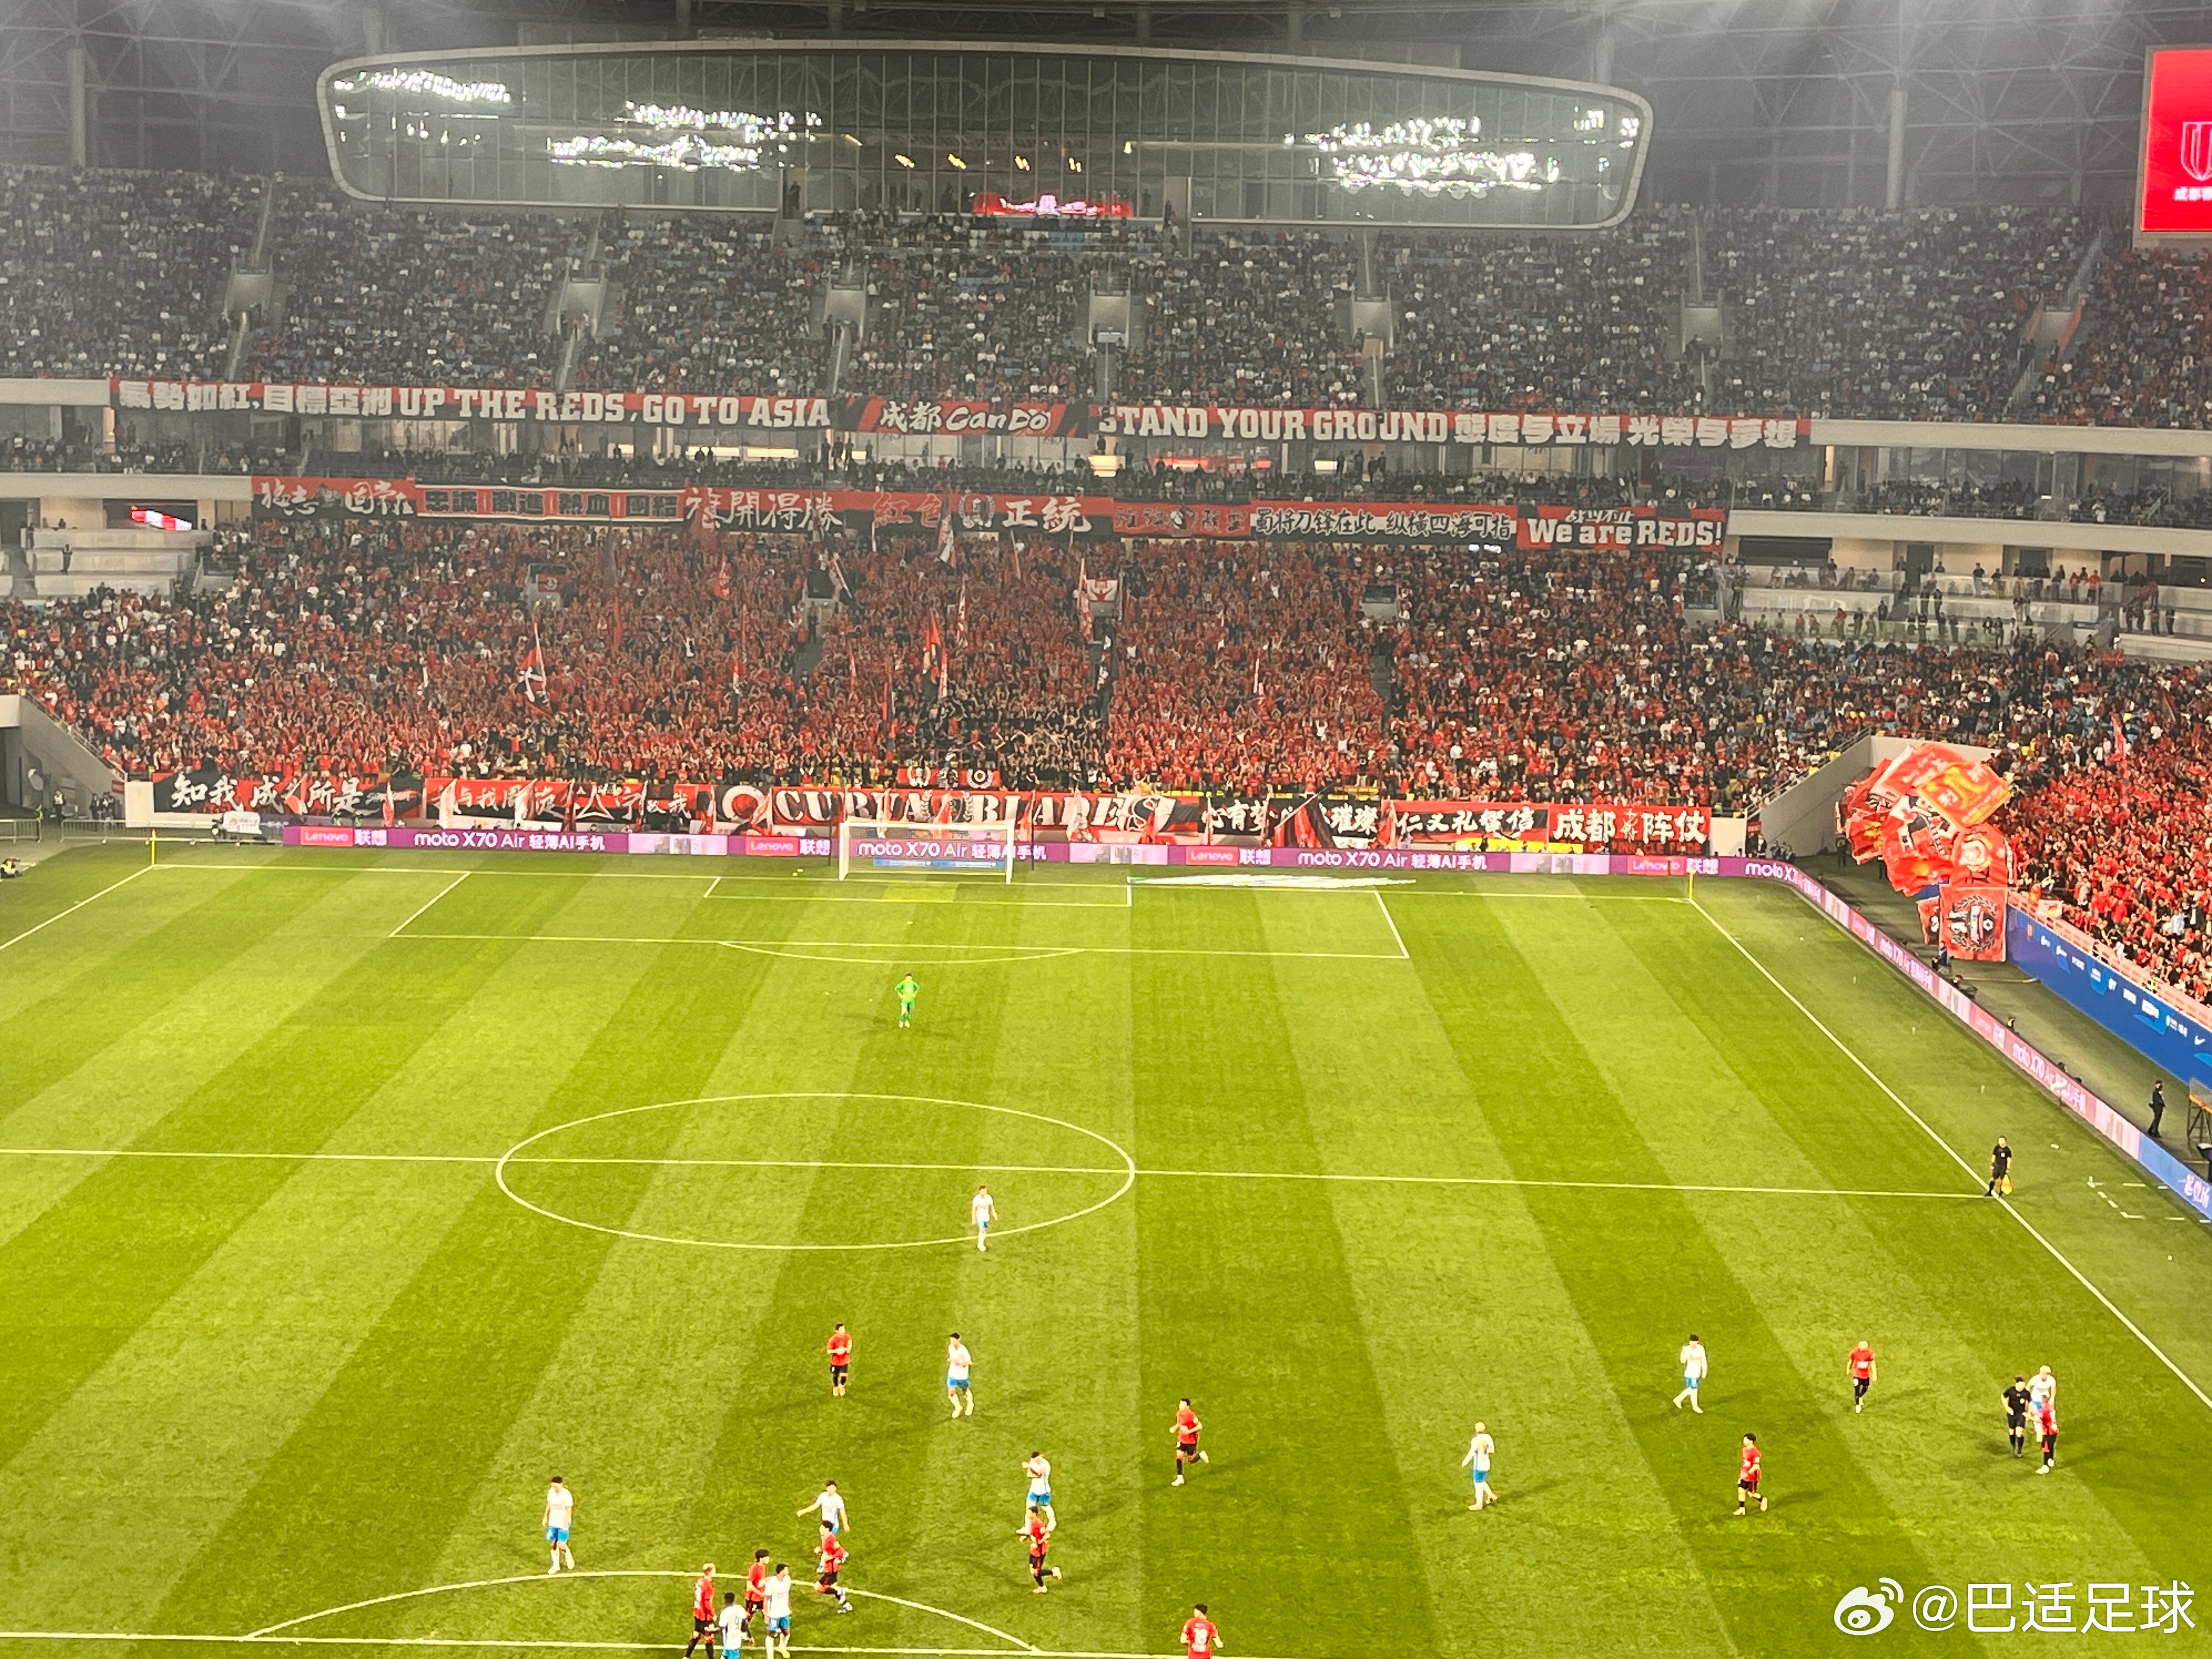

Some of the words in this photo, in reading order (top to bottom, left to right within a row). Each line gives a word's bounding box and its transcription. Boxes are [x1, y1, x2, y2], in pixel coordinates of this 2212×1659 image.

[399, 387, 445, 416] UP
[453, 388, 526, 419] THE
[693, 396, 740, 425] TO
[748, 398, 831, 427] ASIA
[880, 401, 942, 432] 成都
[1098, 406, 1207, 437] STAND
[1217, 408, 1306, 439] YOUR
[1313, 410, 1447, 441] GROUND
[1001, 497, 1092, 533] 正統
[1527, 518, 1573, 543] We
[1579, 524, 1632, 544] are
[1637, 520, 1723, 546] REDS!
[1553, 808, 1616, 843] 成都
[1640, 810, 1708, 845] 阵仗
[304, 830, 348, 842] Lenovo
[355, 829, 387, 845] 联想
[414, 831, 460, 847] moto
[462, 832, 498, 847] X70
[501, 833, 524, 848] Air
[529, 834, 605, 850] 轻薄AI手机
[751, 840, 794, 851] Lenovo
[799, 839, 830, 856] 联想
[859, 840, 902, 856] moto
[905, 842, 940, 856] X70
[944, 843, 968, 857] Air
[1190, 850, 1233, 862] Lenovo
[1239, 849, 1271, 865] 联想
[1298, 850, 1342, 866] moto
[1346, 853, 1380, 866] X70
[1384, 854, 1408, 867] Air
[1412, 854, 1487, 870] 轻薄AI手机
[1633, 860, 1681, 872] Lenovo
[1686, 857, 1719, 874] 联想
[1745, 862, 1784, 879] moto
